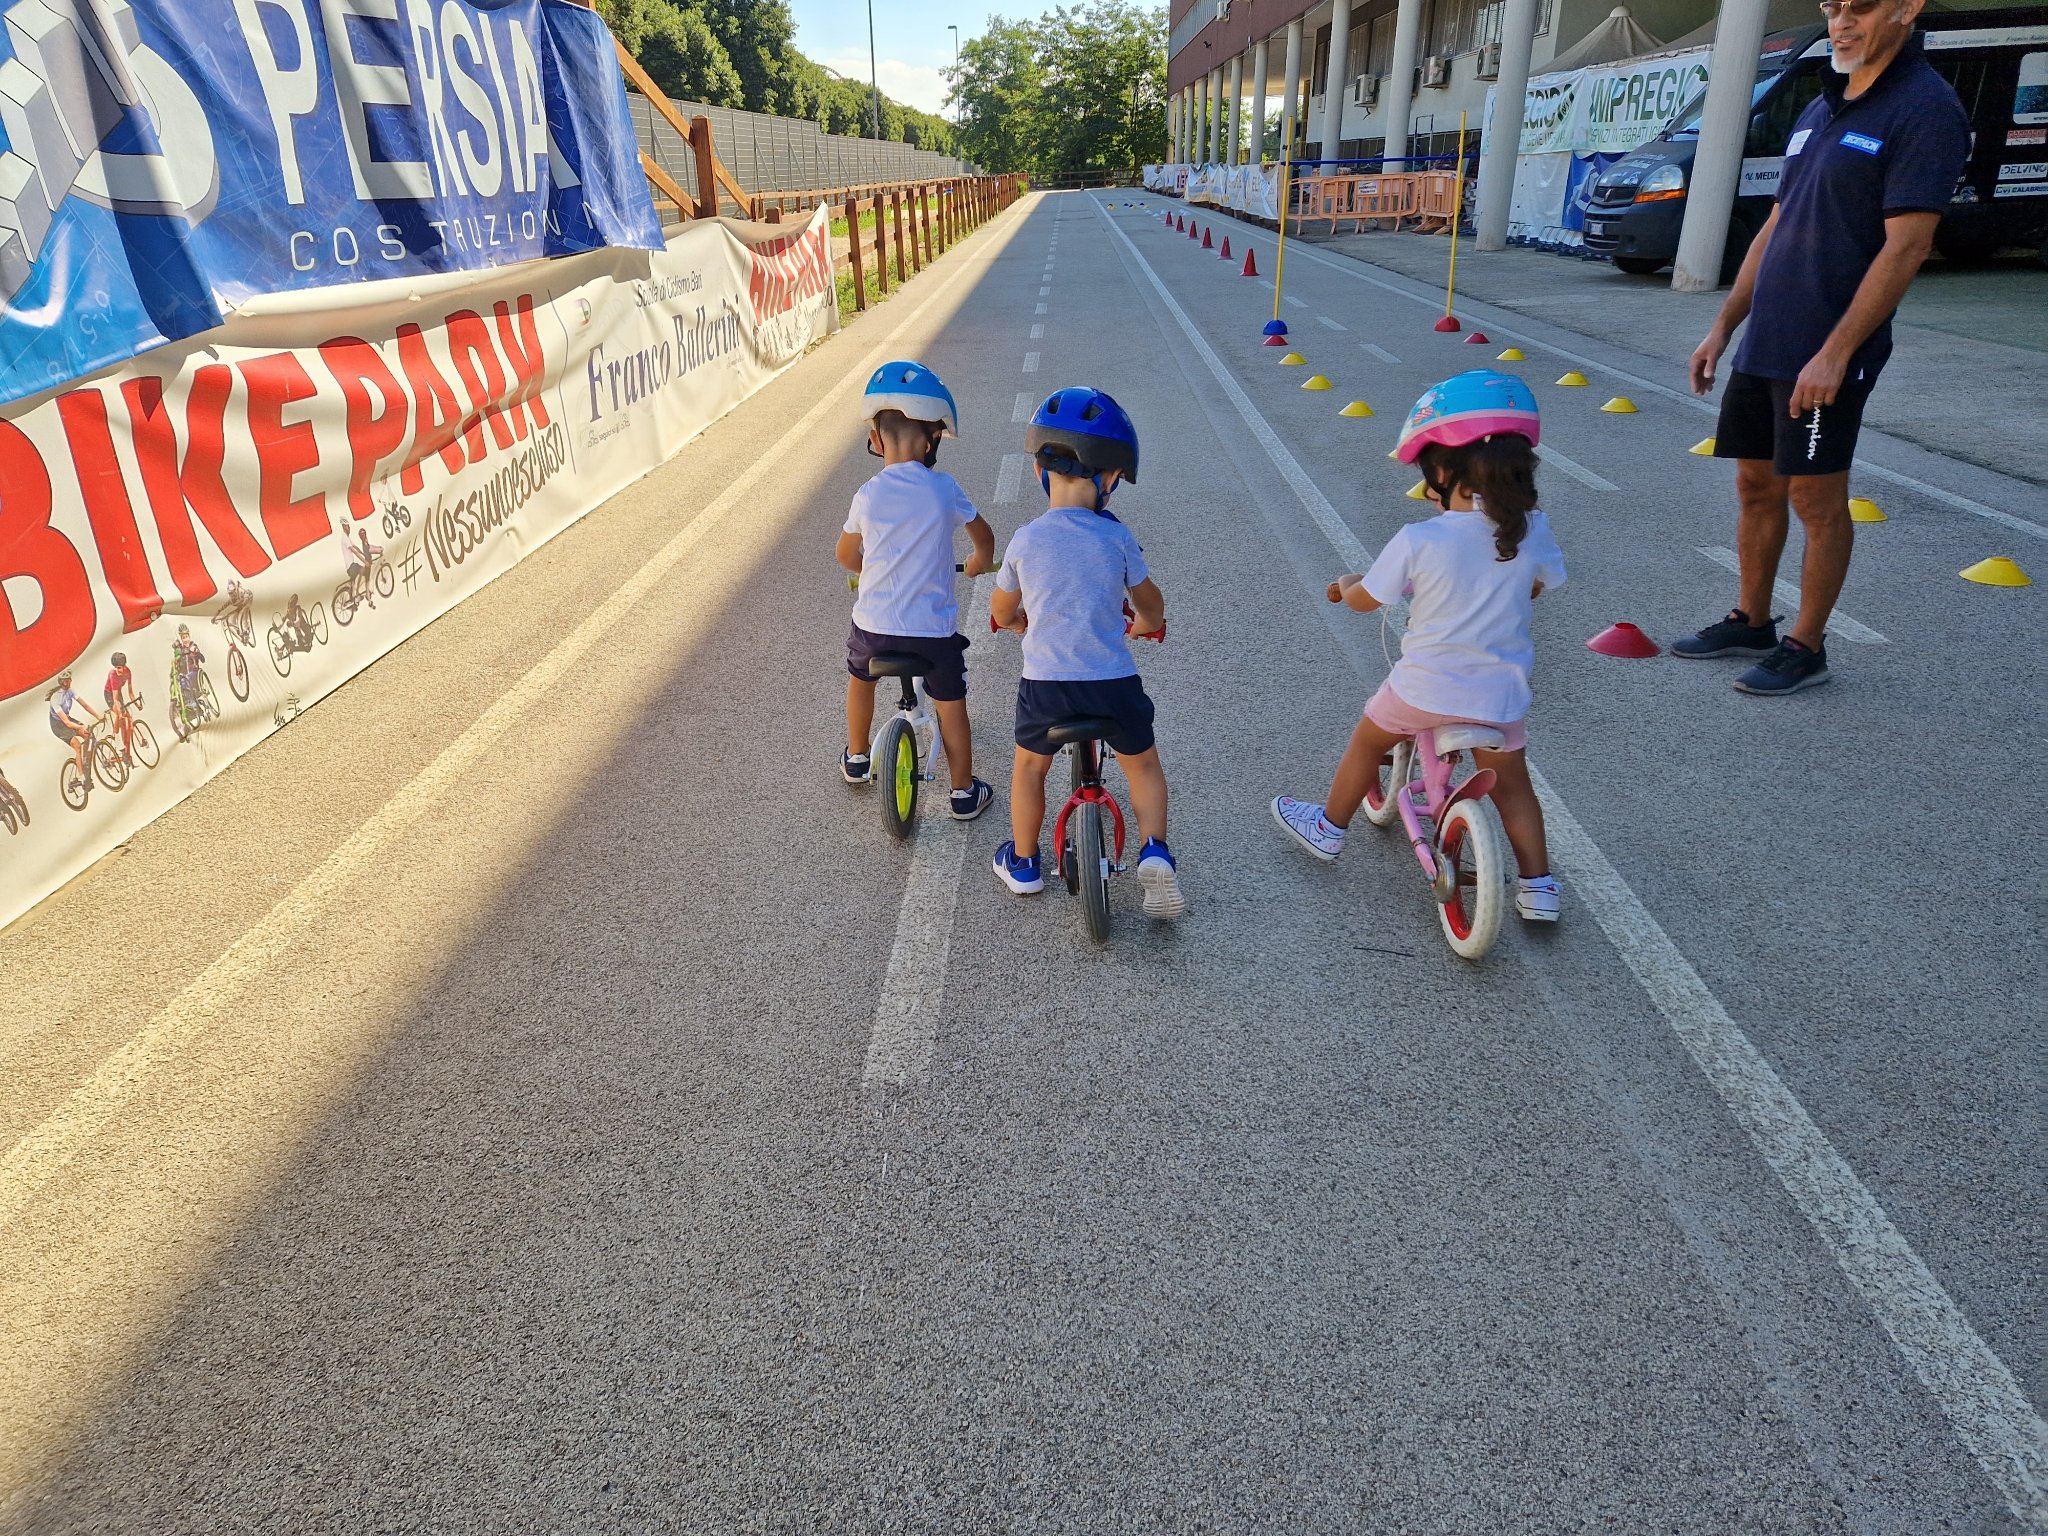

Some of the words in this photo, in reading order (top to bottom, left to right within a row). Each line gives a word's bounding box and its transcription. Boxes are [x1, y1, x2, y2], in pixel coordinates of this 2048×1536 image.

[236, 0, 580, 205] PERSIA
[1842, 134, 1880, 152] DECATHLON
[1755, 170, 1779, 180] MEDIA
[587, 340, 671, 423] Franco
[672, 294, 741, 379] Ballerini
[0, 293, 552, 699] BIKEPARK
[1805, 406, 1821, 460] mpion
[397, 421, 565, 598] #Nessunoescluso
